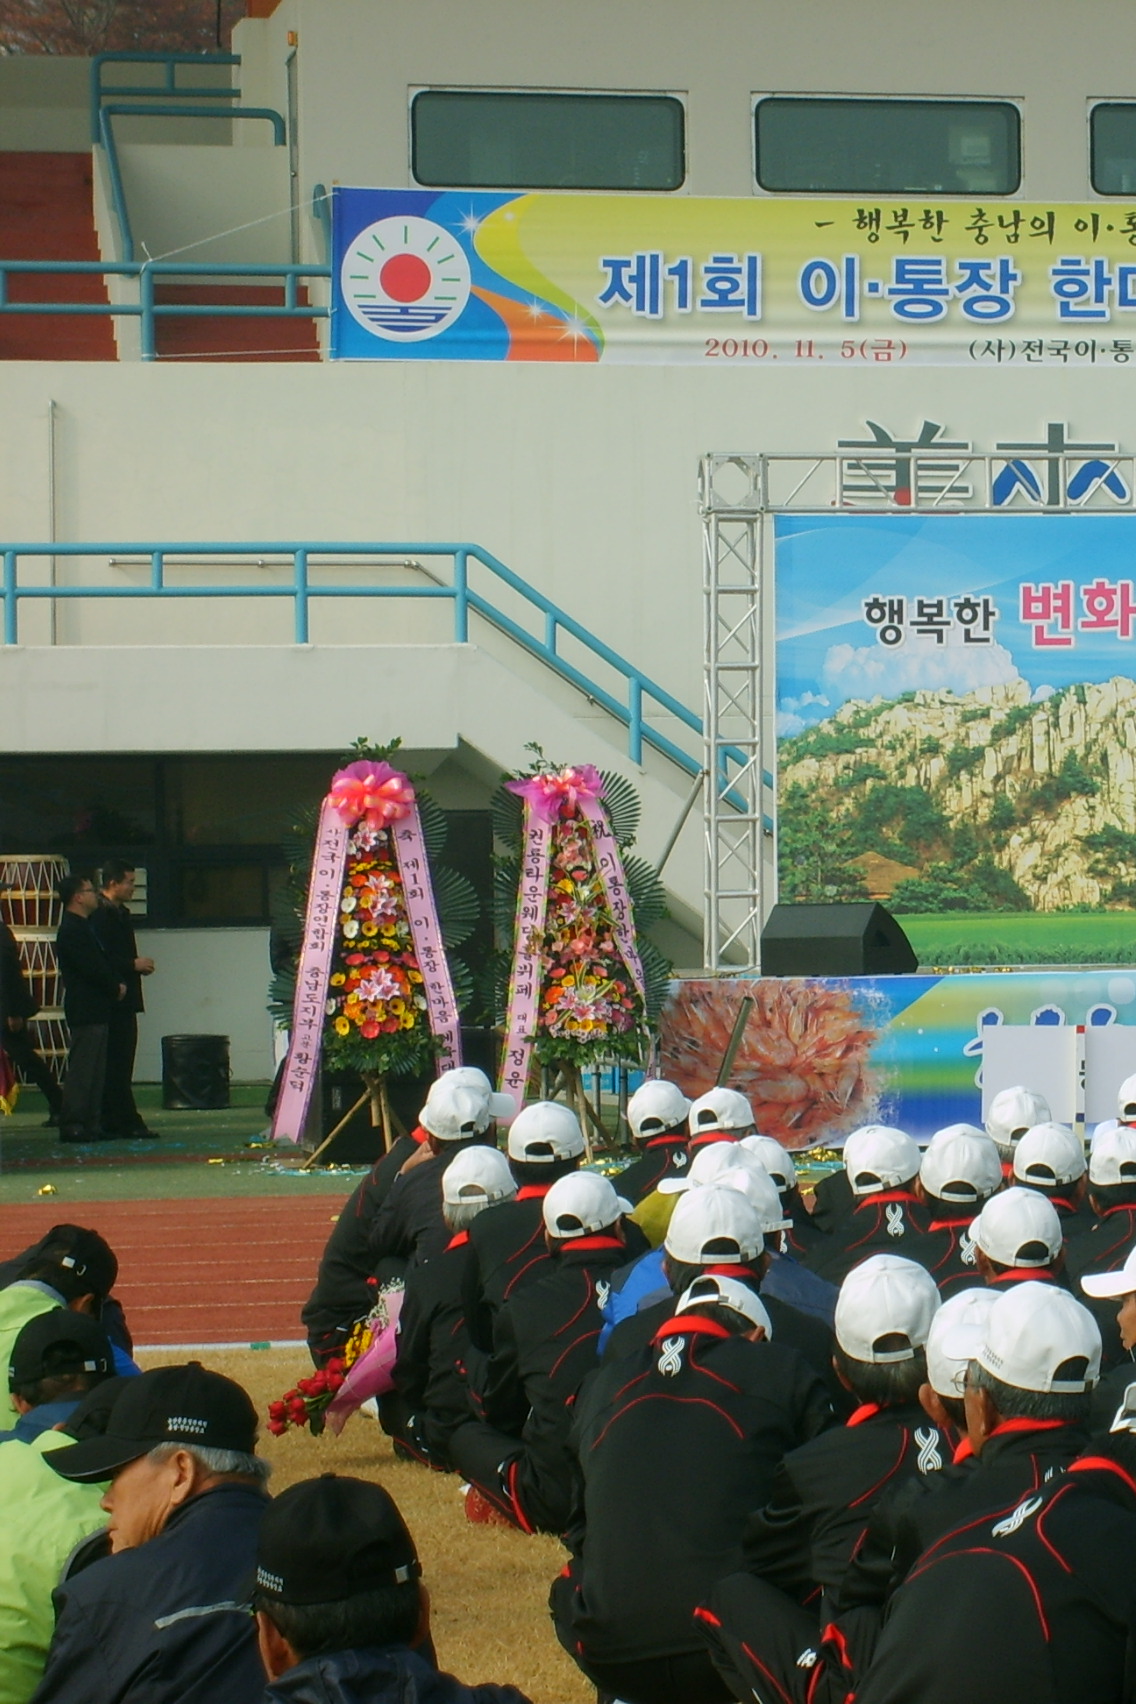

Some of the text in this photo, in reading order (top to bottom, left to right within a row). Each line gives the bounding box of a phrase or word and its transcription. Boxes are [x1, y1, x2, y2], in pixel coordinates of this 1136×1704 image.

[852, 208, 949, 244] 행복한
[965, 208, 1056, 245] 충남의
[599, 251, 760, 319] 제1회
[799, 255, 1019, 322] 이·통장
[705, 338, 907, 361] 2010. 11. 5(금)
[863, 594, 999, 646] 행복한
[592, 820, 612, 838] 祝
[402, 857, 424, 900] 제1회
[428, 981, 450, 1024] 한마음
[516, 1012, 527, 1034] 대표
